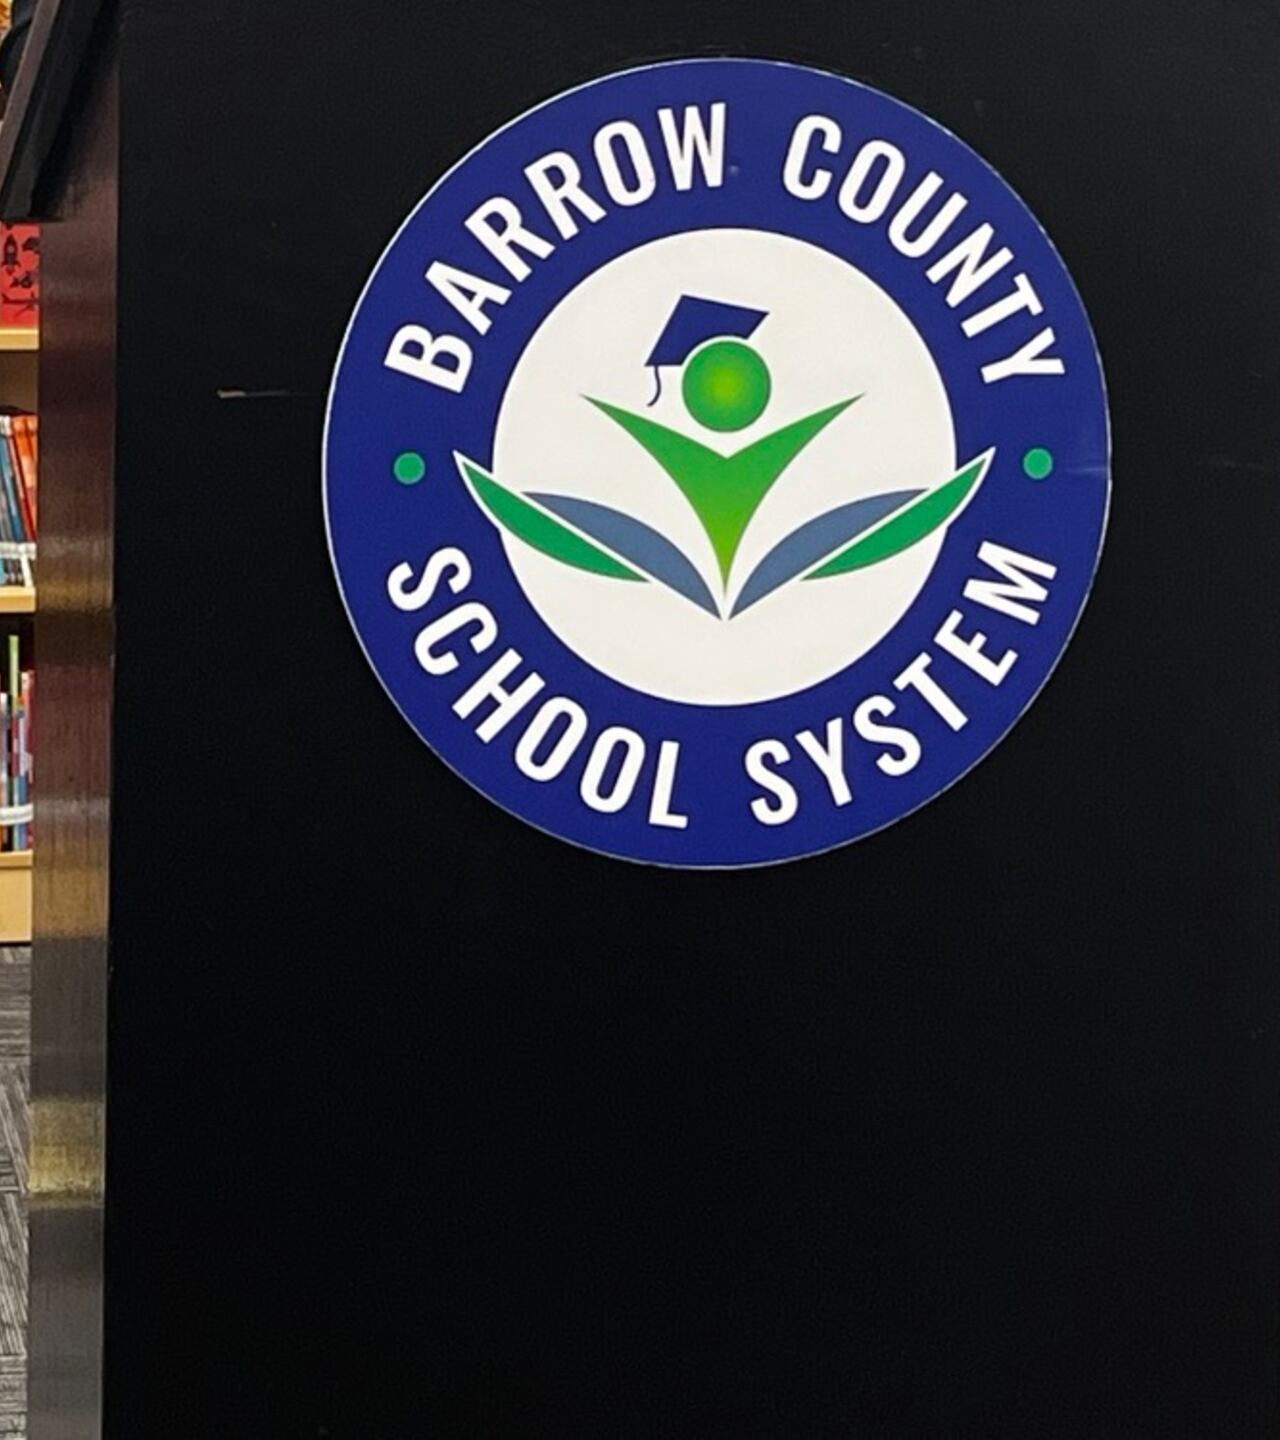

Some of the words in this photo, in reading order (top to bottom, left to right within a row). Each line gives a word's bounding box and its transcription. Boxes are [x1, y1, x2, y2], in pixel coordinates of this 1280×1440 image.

[384, 102, 726, 393] BARROW
[783, 115, 1065, 383] COUNTY
[387, 547, 688, 829] SCHOOL
[745, 541, 1057, 825] SYSTEM
